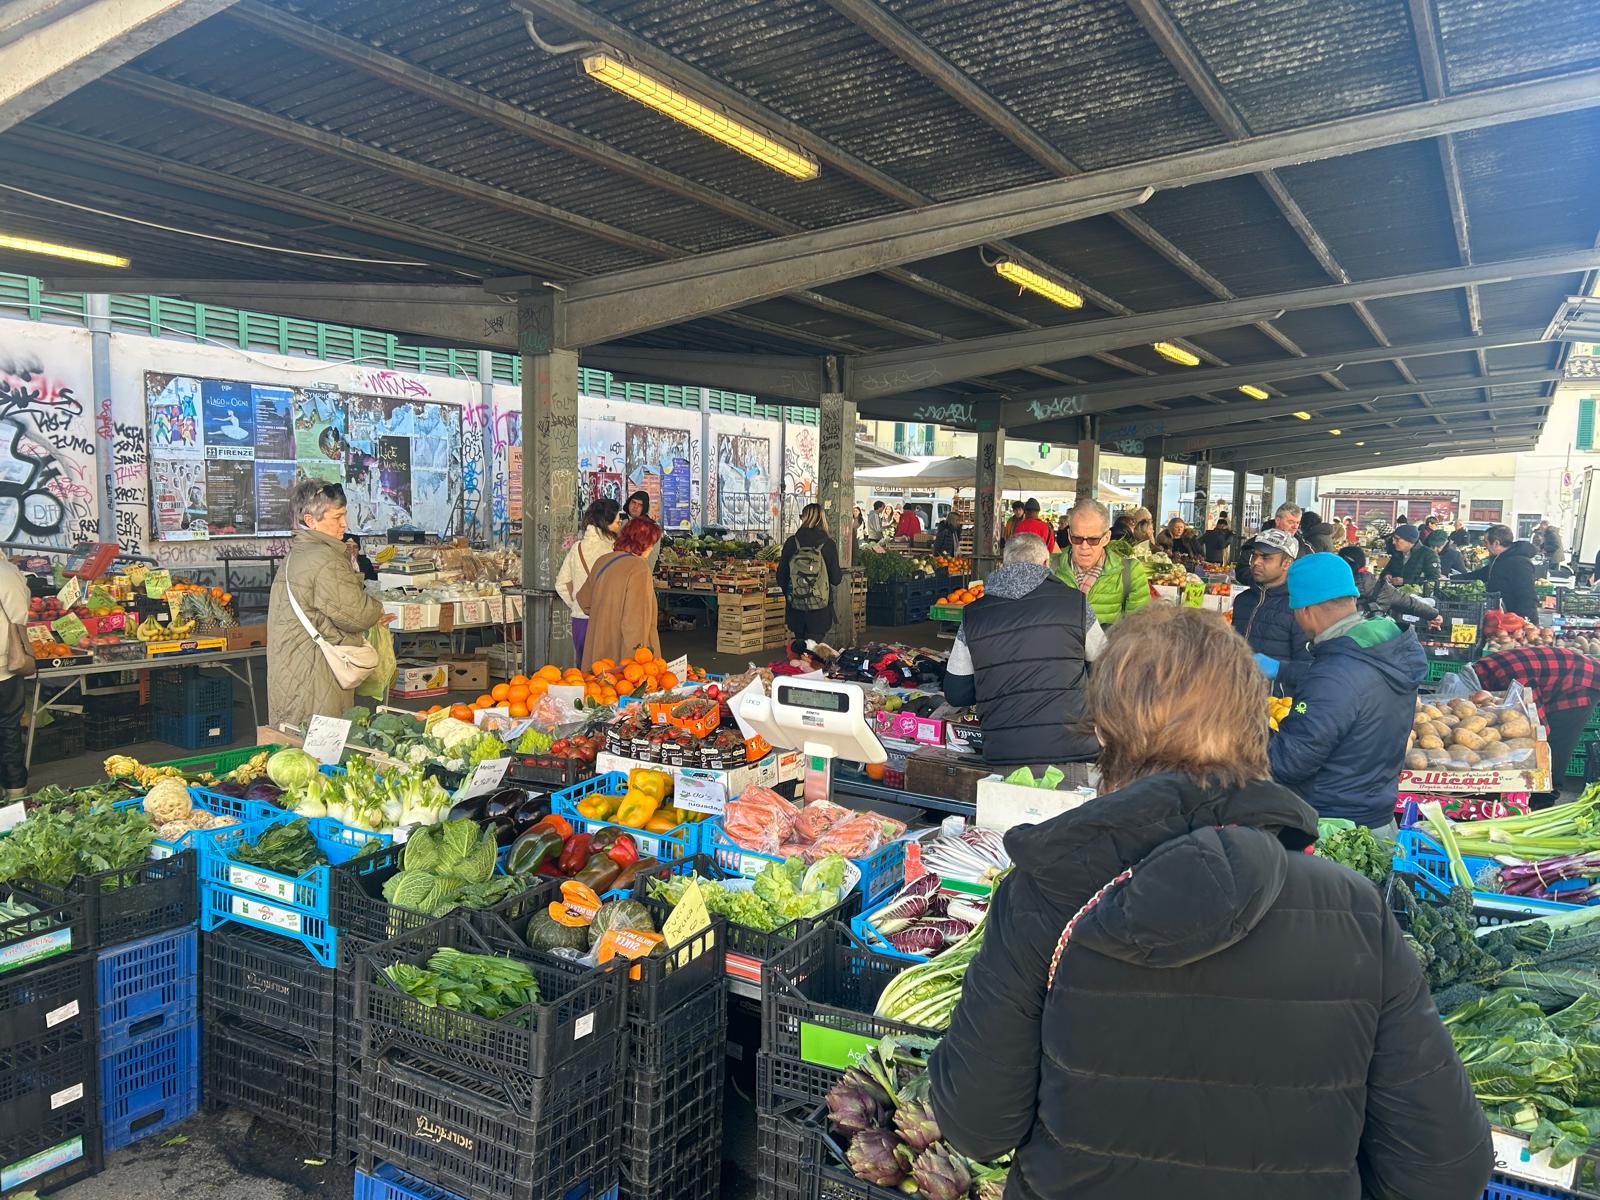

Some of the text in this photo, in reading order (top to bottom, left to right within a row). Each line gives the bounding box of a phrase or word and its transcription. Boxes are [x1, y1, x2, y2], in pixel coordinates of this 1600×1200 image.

[48, 434, 95, 455] ZUMO
[218, 448, 254, 457] FIRENZE
[1399, 769, 1502, 785] Pellicani
[615, 934, 640, 950] ZUCCA
